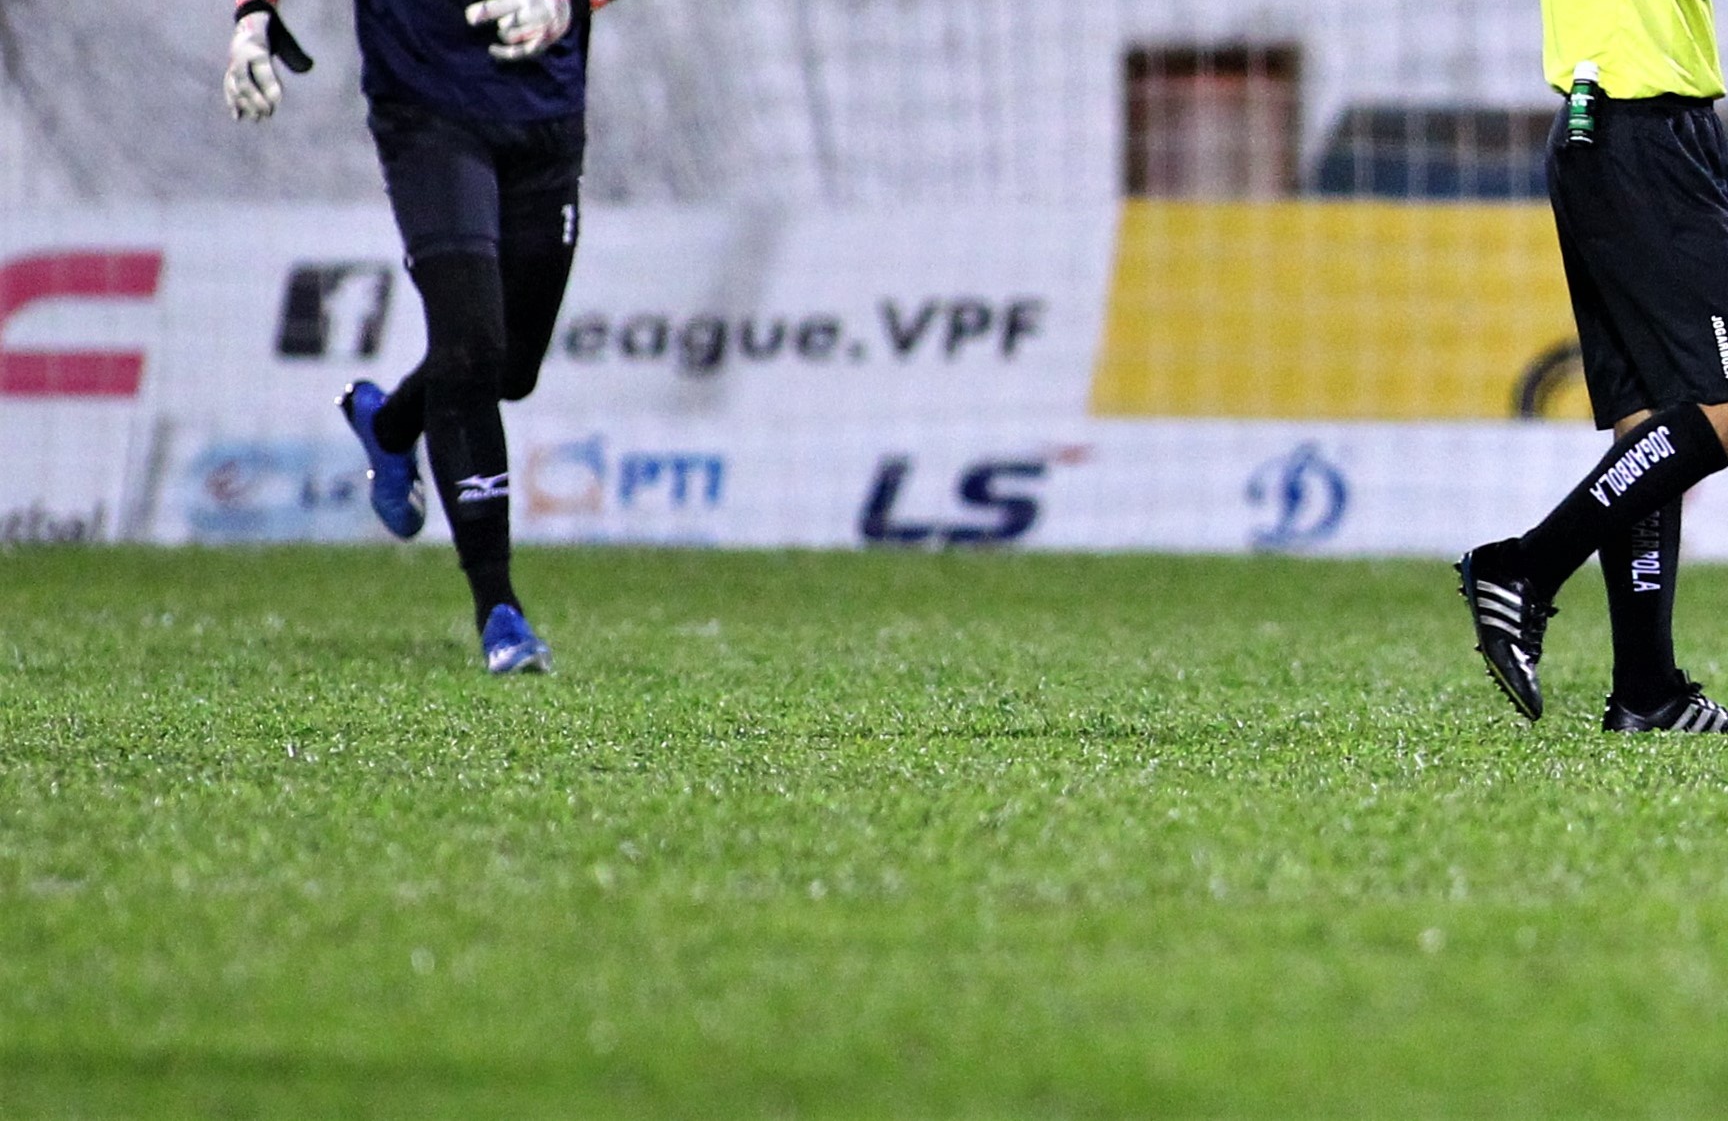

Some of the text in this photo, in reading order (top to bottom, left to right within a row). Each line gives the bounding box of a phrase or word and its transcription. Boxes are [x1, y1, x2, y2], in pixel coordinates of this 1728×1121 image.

[562, 296, 1048, 380] eague.VPF
[619, 449, 728, 508] PTI
[858, 455, 1047, 543] LS
[1589, 425, 1676, 508] JOGARBOLA
